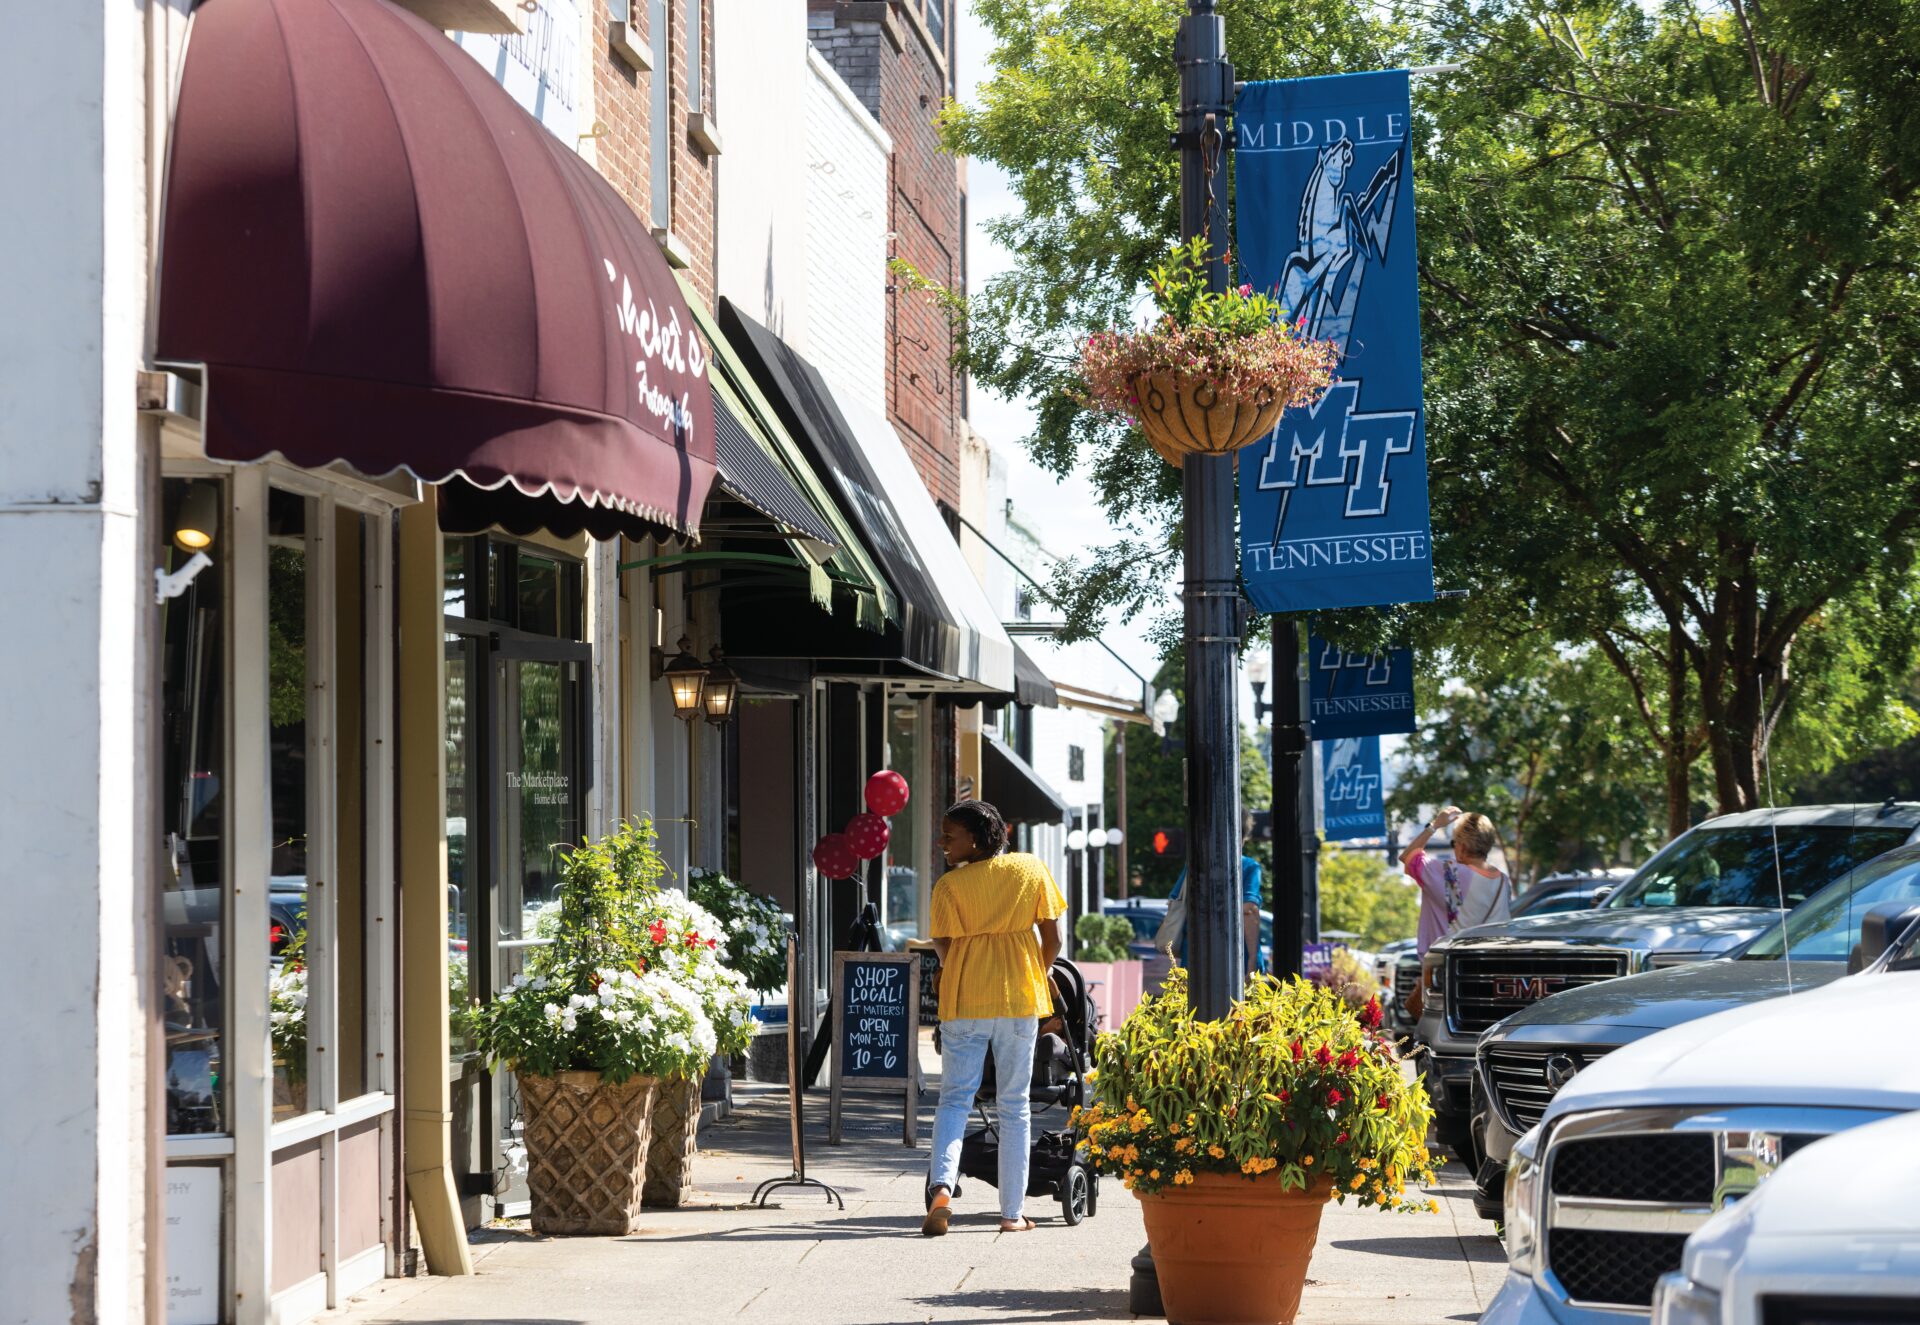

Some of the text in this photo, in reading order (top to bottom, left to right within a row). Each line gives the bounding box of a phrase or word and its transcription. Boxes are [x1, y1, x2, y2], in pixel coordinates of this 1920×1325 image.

[1240, 112, 1404, 148] MIDDLE
[1257, 378, 1417, 519] MT
[1247, 534, 1427, 573] TENNESSEE
[1312, 695, 1412, 716] TENNESSEE
[506, 770, 569, 792] The Marketplace
[1330, 764, 1379, 810] MT
[534, 792, 569, 804] Home & Gift
[854, 966, 899, 988] SHOP
[851, 984, 904, 1004] LOCAL!
[1493, 977, 1566, 1000] GMC
[847, 1004, 905, 1016] IT MATTERS!
[860, 1018, 890, 1032] OPEN
